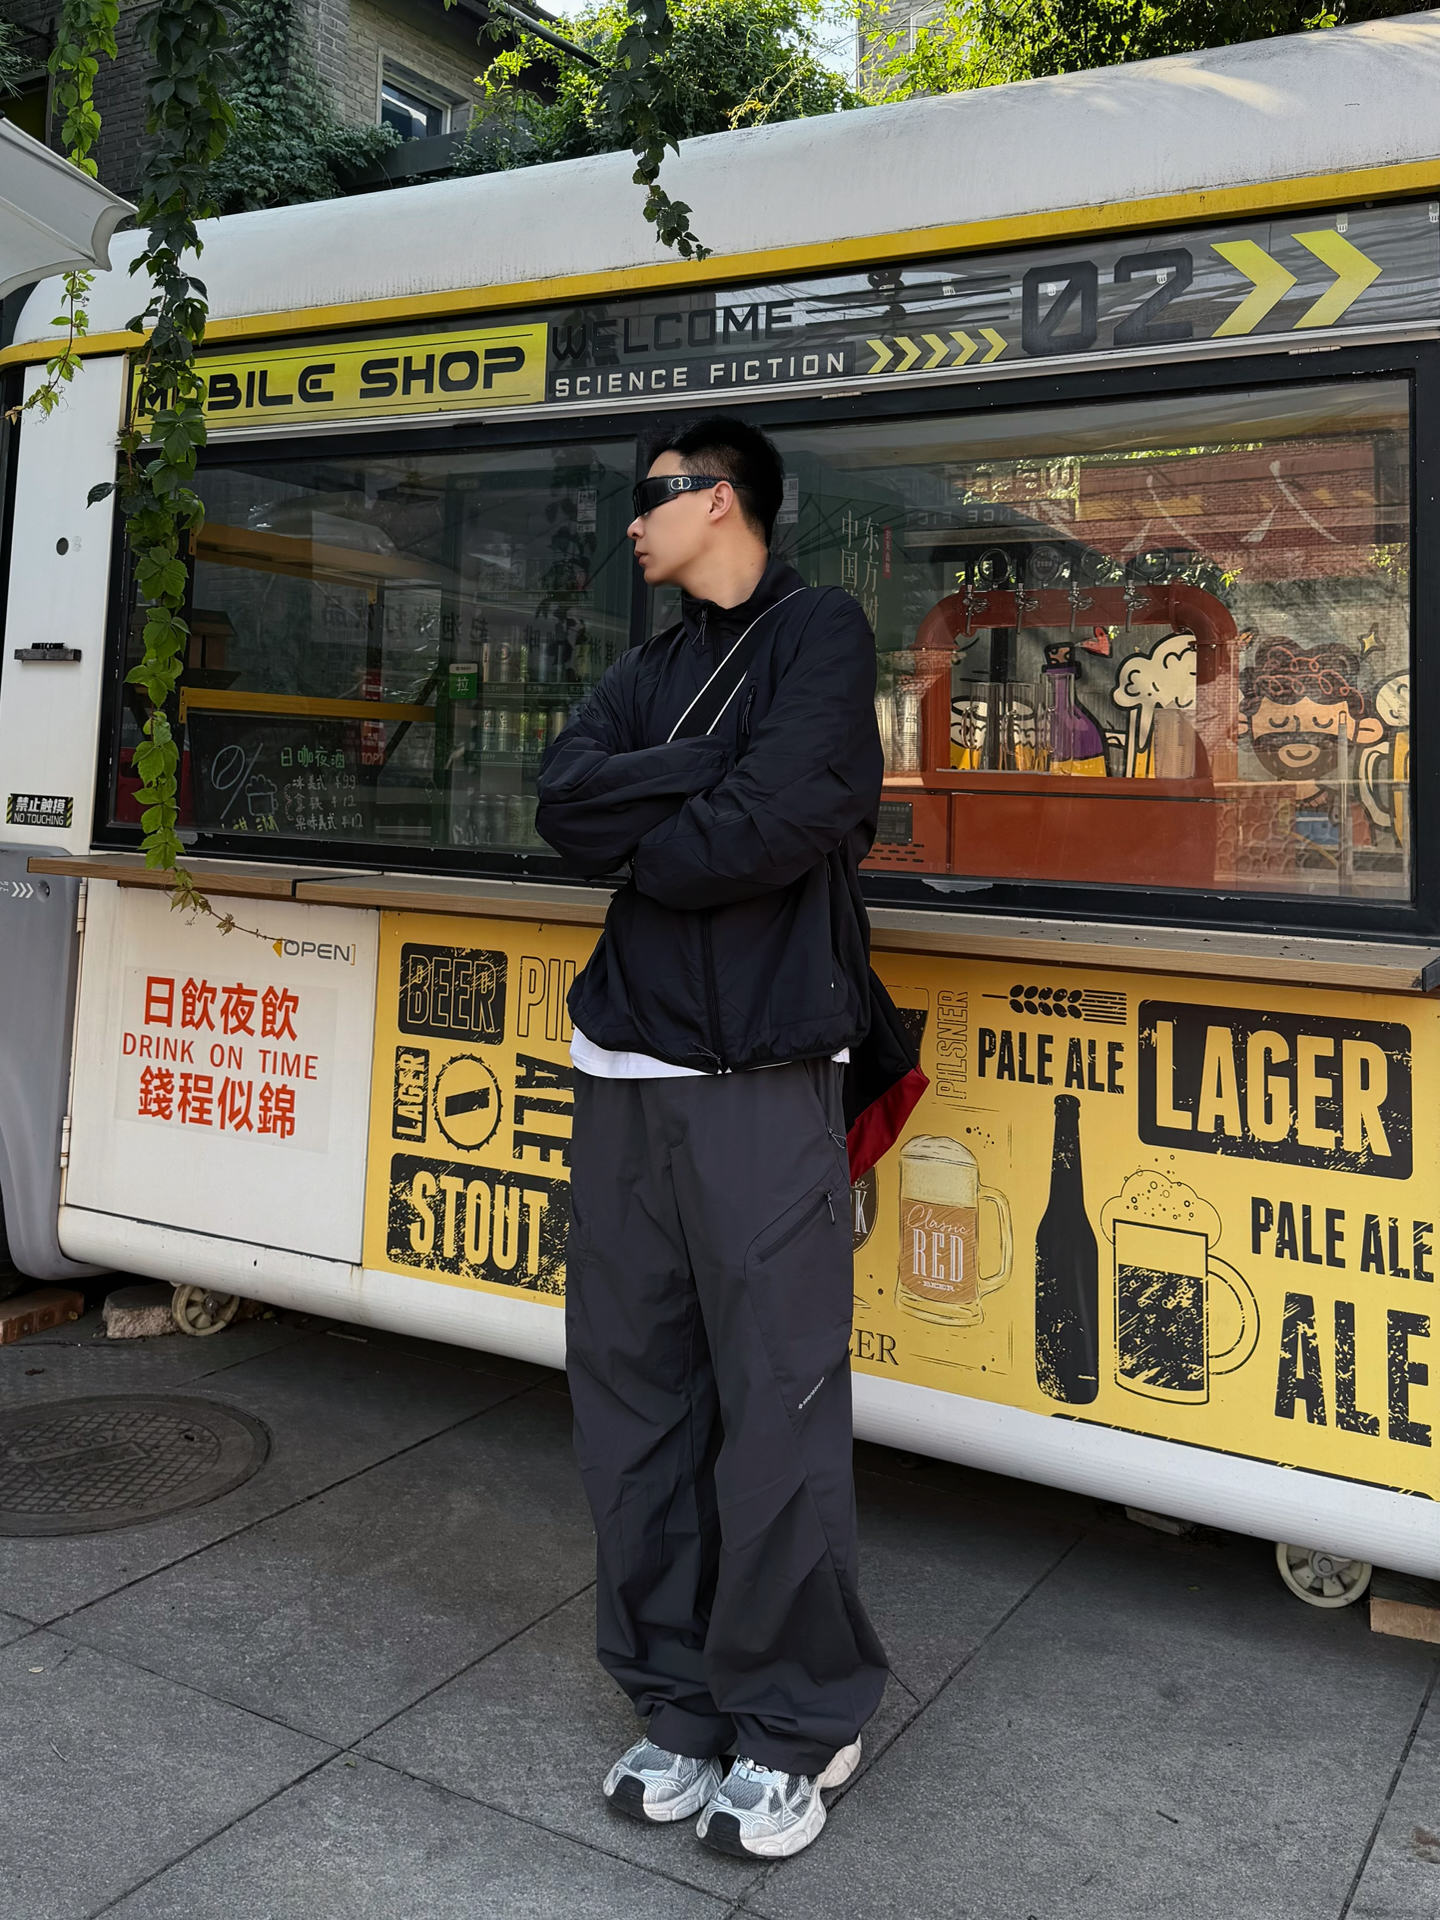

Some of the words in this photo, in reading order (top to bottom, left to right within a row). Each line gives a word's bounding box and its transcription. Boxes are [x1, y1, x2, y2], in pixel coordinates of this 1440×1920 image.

[551, 300, 794, 361] WELCOME
[1021, 247, 1194, 356] 02
[359, 345, 526, 399] SHOP
[555, 366, 688, 397] SCIENCE
[709, 352, 844, 384] FICTION
[841, 510, 859, 597] 中国
[456, 676, 470, 692] 拉
[280, 744, 346, 769] 日咖夜酒
[13, 812, 26, 823] NO
[26, 813, 65, 826] TOUCHING
[15, 796, 66, 815] 禁止触摸
[143, 975, 300, 1042] 日飲夜飲
[406, 953, 497, 1034] BEER
[122, 1032, 195, 1065] DRINK
[209, 1043, 244, 1071] ON
[258, 1049, 319, 1081] TIME
[935, 989, 969, 1100] PILSNER
[977, 1027, 1054, 1086] PALE
[1064, 1036, 1125, 1095] ALE
[137, 1064, 297, 1140] 錢程似錦
[395, 1052, 426, 1137] LAGER
[1154, 1018, 1393, 1158] LAGER
[408, 1169, 549, 1277] STOUT
[907, 1203, 971, 1235] Classic
[1250, 1195, 1347, 1270] PALE
[1359, 1212, 1435, 1284] ALE
[911, 1227, 965, 1283] RED
[849, 1328, 900, 1366] ER
[1274, 1291, 1433, 1448] ALE
